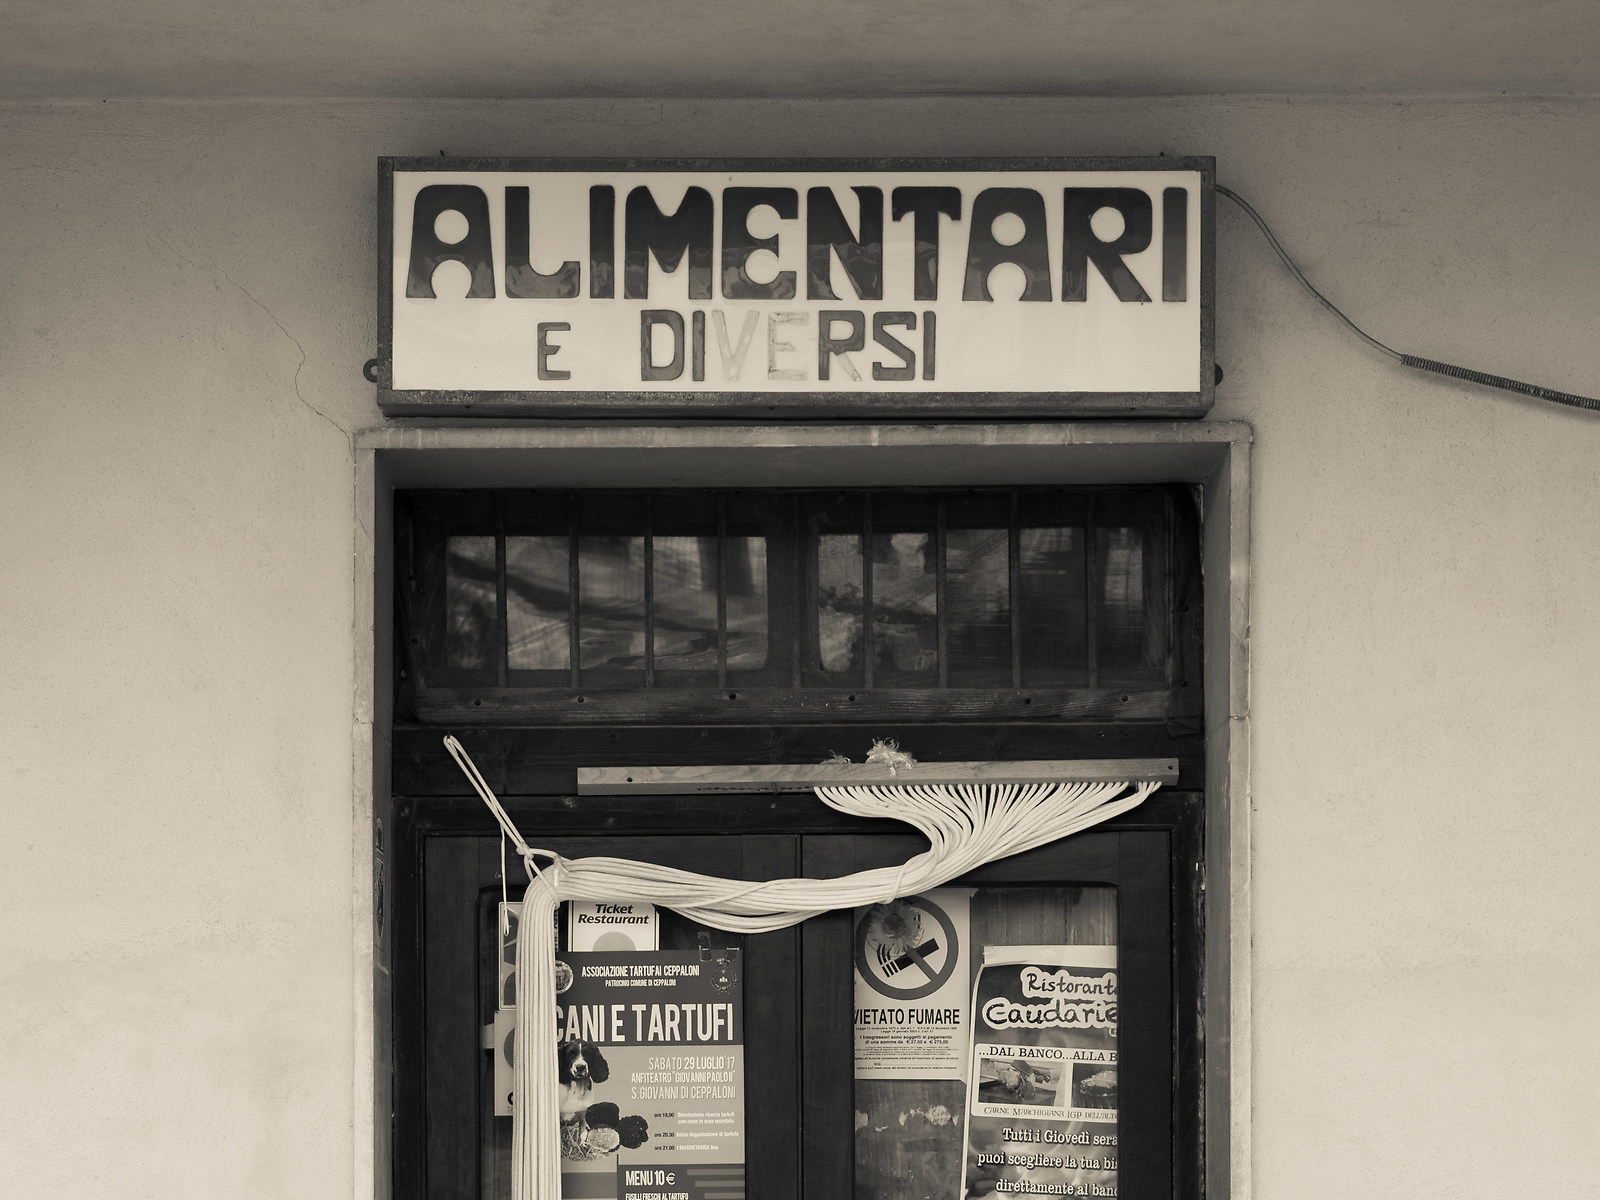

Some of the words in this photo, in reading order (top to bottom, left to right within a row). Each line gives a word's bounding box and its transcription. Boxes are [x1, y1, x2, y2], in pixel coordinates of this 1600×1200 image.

[406, 185, 1188, 303] ALIMENTARI
[537, 322, 571, 380] E
[640, 310, 936, 382] DIVERSI
[594, 904, 634, 914] Ticket
[578, 914, 650, 924] Restaurant
[582, 966, 628, 978] ASSOCIAZIONE
[630, 965, 662, 977] TARTUFAI
[664, 964, 700, 976] CEPPALONI
[612, 1004, 625, 1042] E
[632, 1003, 734, 1042] TARTUFI
[854, 1008, 904, 1024] VIETATO
[908, 1008, 960, 1024] FUMARE
[648, 1056, 682, 1070] SABATO
[684, 1056, 695, 1070] 29
[696, 1056, 724, 1070] LUGLIO
[631, 1072, 672, 1083] ANFITEATRO
[707, 1072, 728, 1083] PAOLO
[681, 1086, 688, 1099] DI
[690, 1086, 736, 1099] CEPPALONI
[984, 1106, 1010, 1114] CARNE
[1002, 1128, 1033, 1142] Tutti
[1035, 1130, 1040, 1143] i
[1044, 1130, 1089, 1145] Giovedì
[977, 1152, 1005, 1168] puoi
[1008, 1154, 1062, 1169] scegliere
[1065, 1156, 1077, 1168] la
[1080, 1158, 1100, 1169] tua
[626, 1170, 653, 1186] MENU
[996, 1179, 1074, 1195] direttamente
[1077, 1183, 1088, 1195] al
